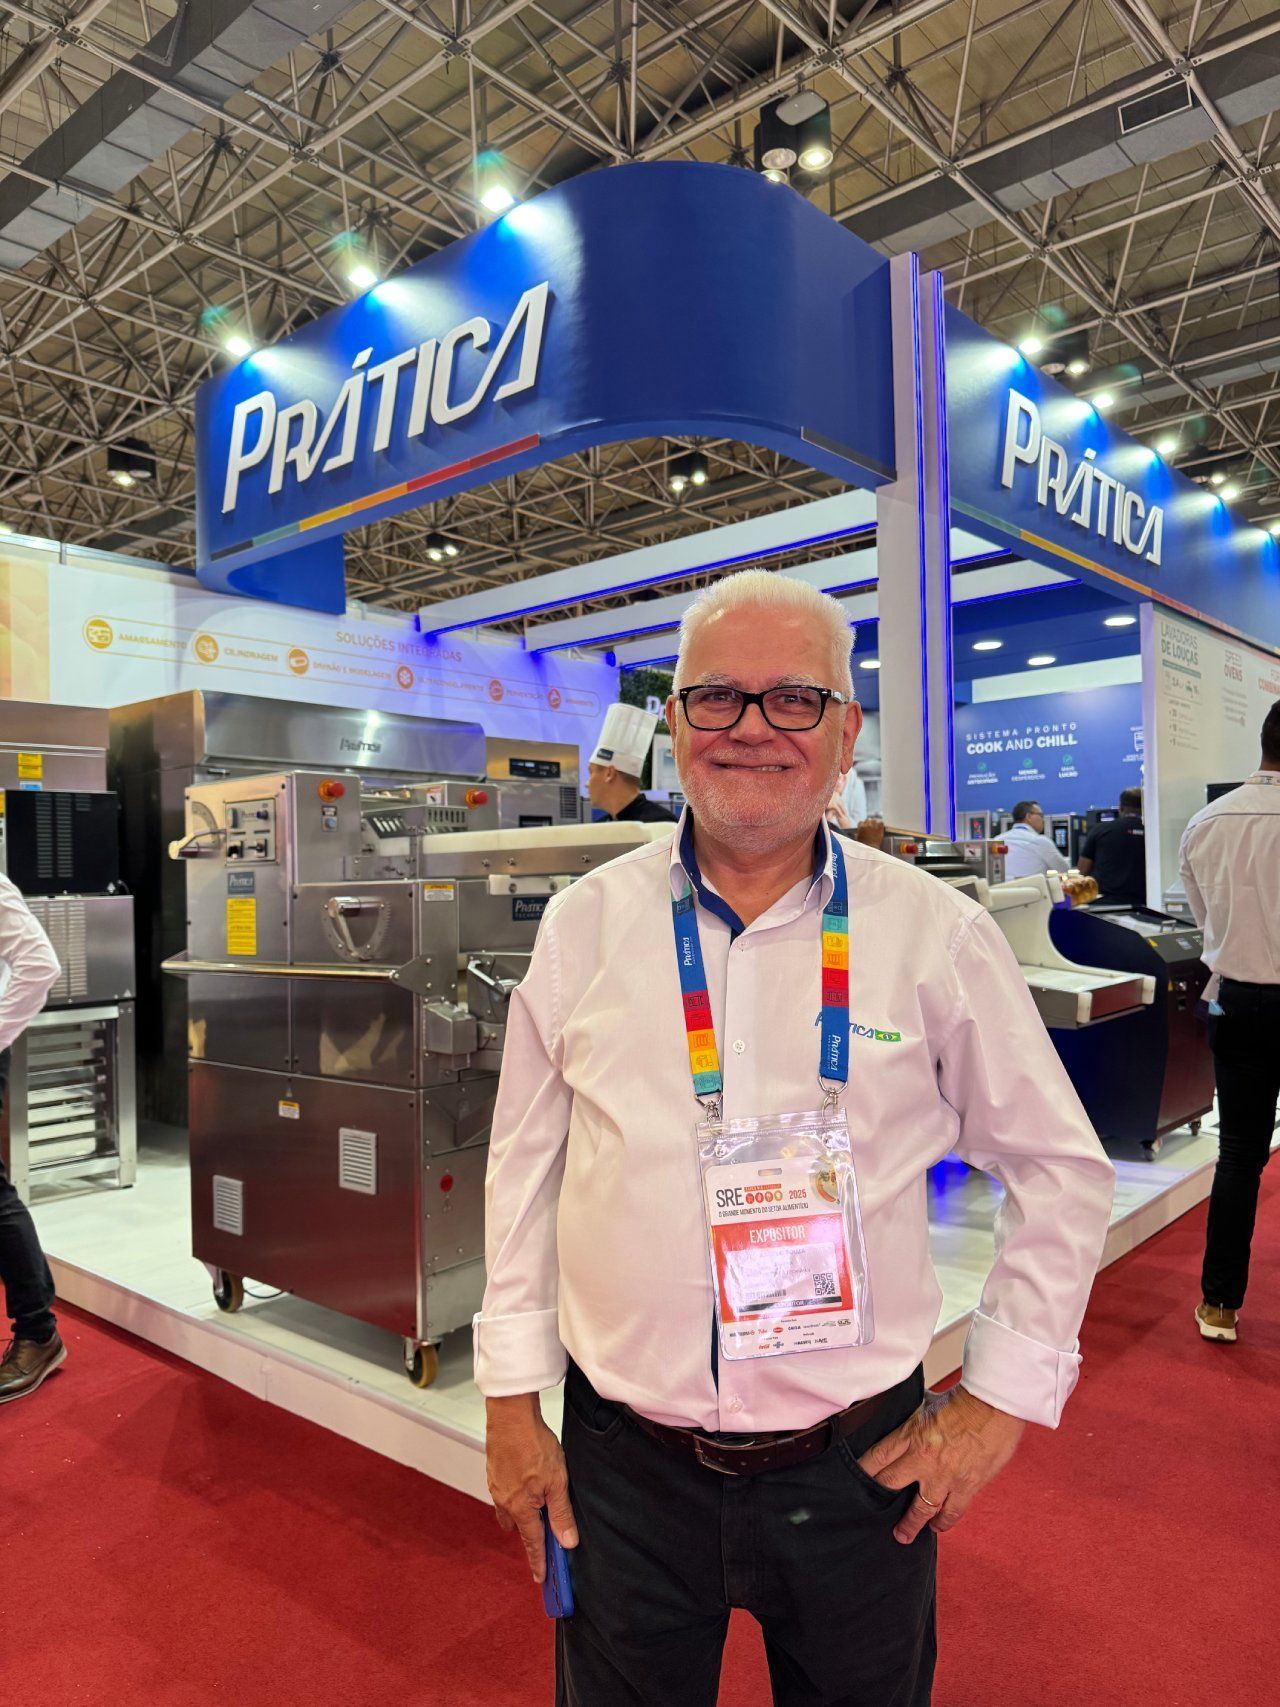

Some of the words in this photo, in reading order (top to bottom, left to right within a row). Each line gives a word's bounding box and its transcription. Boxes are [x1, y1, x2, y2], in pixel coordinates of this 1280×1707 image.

[222, 281, 548, 514] PRÁTICA
[1001, 388, 1164, 566] PRÁTICA
[335, 630, 395, 651] SOLUÇÕES
[398, 642, 463, 663] INTEGRADAS
[1161, 639, 1171, 656] DE
[966, 728, 1018, 741] SISTEMA
[1026, 721, 1078, 735] PRONTO
[966, 740, 1003, 755] COOK
[1005, 738, 1034, 751] AND
[1036, 733, 1078, 748] CHILL
[716, 1187, 745, 1208] SRE
[788, 1189, 807, 1200] 2025
[749, 1224, 806, 1244] EXPOSITOR
